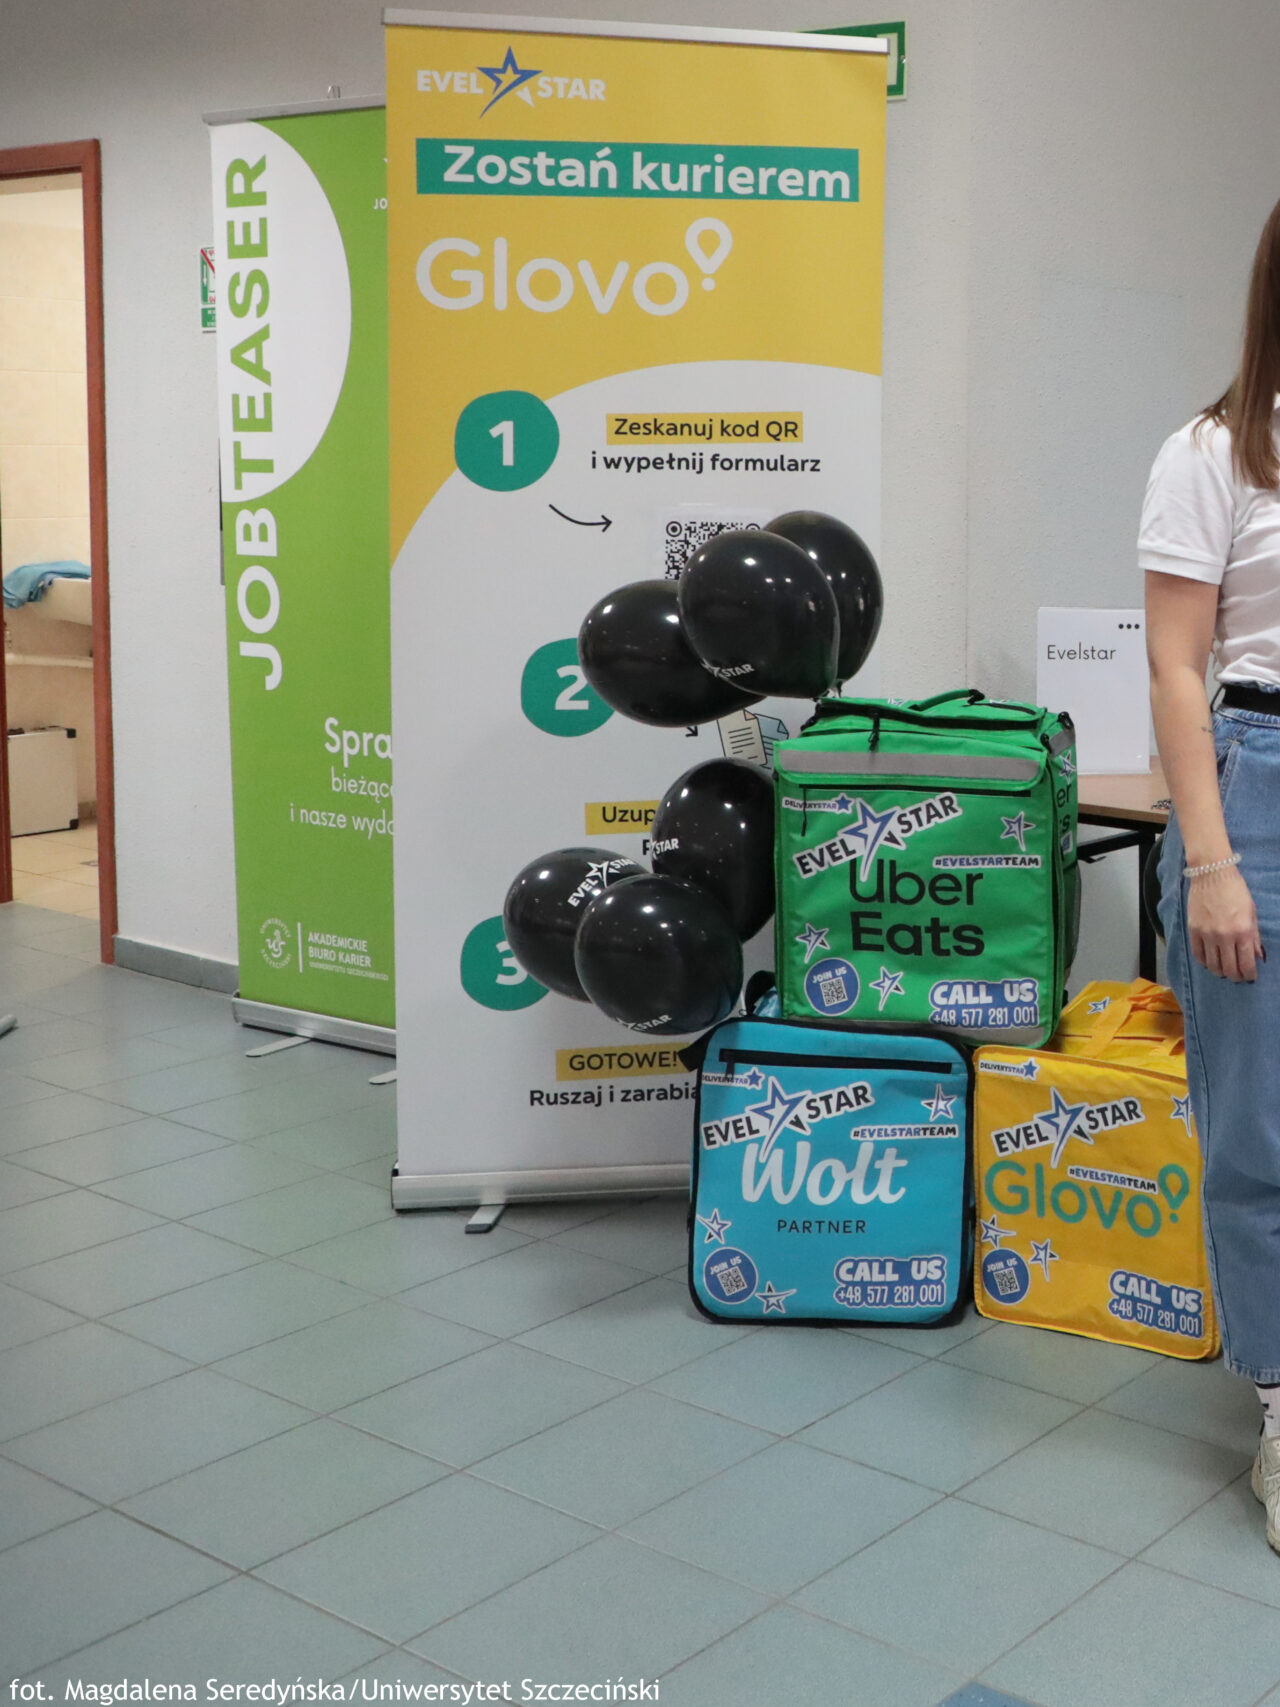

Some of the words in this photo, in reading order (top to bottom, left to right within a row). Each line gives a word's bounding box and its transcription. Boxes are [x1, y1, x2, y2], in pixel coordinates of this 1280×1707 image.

[416, 69, 483, 95] EVEL
[537, 75, 606, 101] STAR
[443, 145, 618, 189] Zostań
[632, 151, 851, 200] kurierem
[415, 236, 691, 317] Glovo
[614, 416, 713, 441] Zeskanuj
[720, 419, 761, 438] kod
[765, 420, 799, 440] QR
[488, 420, 514, 467] 1
[591, 451, 597, 470] i
[602, 452, 704, 474] wypełnij
[711, 453, 821, 473] formularz
[1047, 641, 1116, 661] Evelstar
[555, 664, 590, 711] 2
[324, 716, 392, 768] Spra
[290, 803, 295, 822] i
[300, 807, 347, 829] nasze
[602, 806, 655, 826] Uzup
[655, 838, 679, 854] STAR
[798, 838, 857, 876] EVEL
[896, 794, 959, 835] STAR
[934, 856, 1039, 867] #EVELSTARTEAM
[567, 878, 598, 907] EVEL
[849, 858, 984, 906] Uber
[307, 931, 368, 953] AKADEMICKIE
[850, 910, 985, 957] Eats
[308, 946, 337, 962] BIURO
[338, 951, 372, 968] KARIER
[495, 940, 529, 986] 3
[811, 970, 833, 984] JOIN
[834, 966, 847, 977] US
[933, 981, 993, 1007] CALL
[1004, 981, 1036, 1004] US
[932, 1008, 957, 1026] +48
[961, 1007, 983, 1027] 577
[988, 1006, 1009, 1025] 281
[1013, 1005, 1036, 1024] 001
[569, 1050, 678, 1071] GOTOWE!
[980, 1061, 1025, 1075] DELIVERYSTAR
[529, 1085, 602, 1107] Ruszaj
[609, 1085, 614, 1103] i
[703, 1114, 760, 1148] EVEL
[805, 1084, 872, 1121] STAR
[994, 1123, 1050, 1154] EVEL
[1084, 1099, 1143, 1131] STAR
[853, 1126, 957, 1138] #EVELSTARTEAM
[741, 1140, 909, 1206] Wolt
[1069, 1167, 1158, 1192] #EVELSTARTEAM
[984, 1159, 1162, 1238] Glovo
[777, 1219, 866, 1234] PARTNER
[710, 1262, 729, 1276] JOIN
[730, 1255, 743, 1266] US
[837, 1260, 899, 1283] CALL
[911, 1260, 943, 1281] US
[986, 1260, 1005, 1272] JOIN
[1006, 1257, 1018, 1267] US
[837, 1285, 862, 1304] +48
[867, 1286, 888, 1305] 577
[894, 1286, 914, 1304] 281
[919, 1285, 942, 1303] 001
[1111, 1273, 1162, 1306] CALL
[1171, 1289, 1200, 1314] US
[1111, 1300, 1133, 1319] +48
[1136, 1304, 1155, 1325] 577
[1157, 1309, 1176, 1331] 281
[1180, 1315, 1200, 1336] 001
